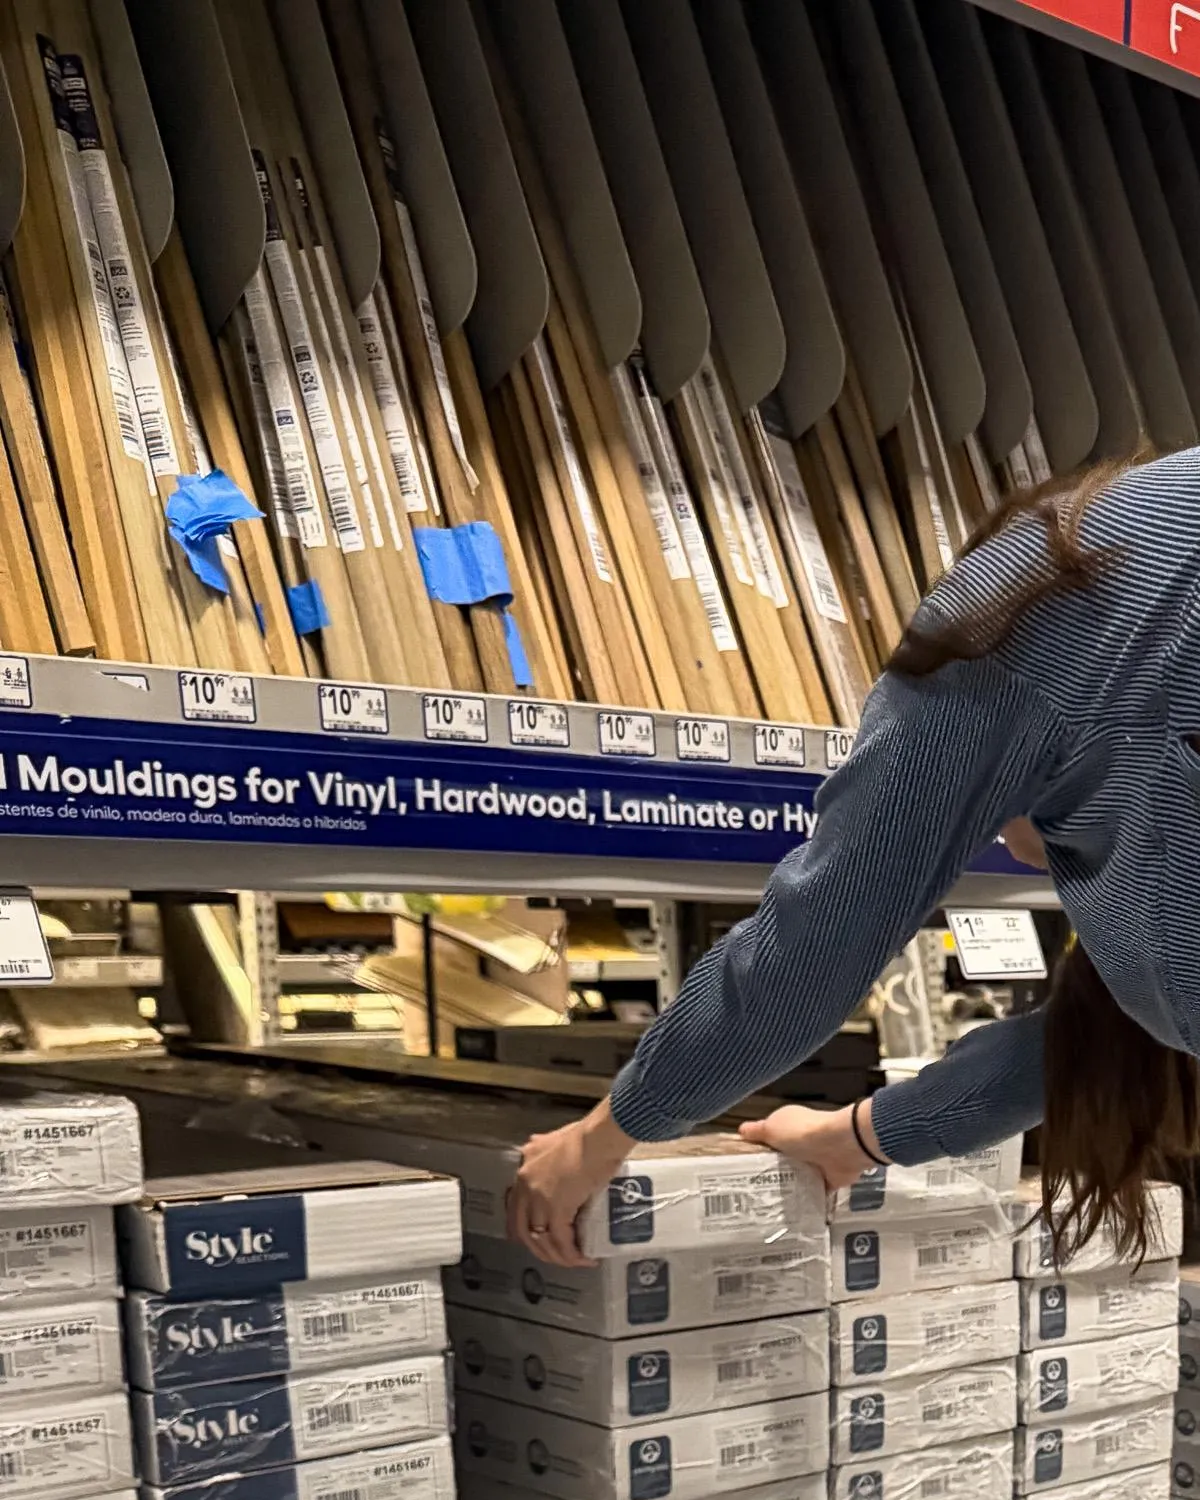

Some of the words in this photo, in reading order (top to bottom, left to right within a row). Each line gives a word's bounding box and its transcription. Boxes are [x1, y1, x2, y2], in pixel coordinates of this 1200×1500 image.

[17, 754, 238, 808] Mouldings
[244, 766, 300, 804] for
[307, 770, 407, 816] Vinyl,
[414, 776, 596, 826] Hardwood,
[602, 790, 744, 830] Laminate
[749, 808, 778, 831] or
[57, 803, 78, 818] de
[81, 805, 124, 822] vinilo,
[127, 806, 187, 823] madera
[189, 810, 226, 826] dura,
[229, 811, 301, 828] laminados
[302, 817, 313, 829] o
[23, 1125, 94, 1140] #1451667
[16, 1224, 87, 1241] #1451667
[186, 1227, 273, 1268] Style
[361, 1283, 420, 1302] #1451667
[166, 1316, 251, 1357] Style
[364, 1372, 424, 1393] #1451667
[173, 1408, 259, 1450] Style
[373, 1457, 431, 1478] #1451667
